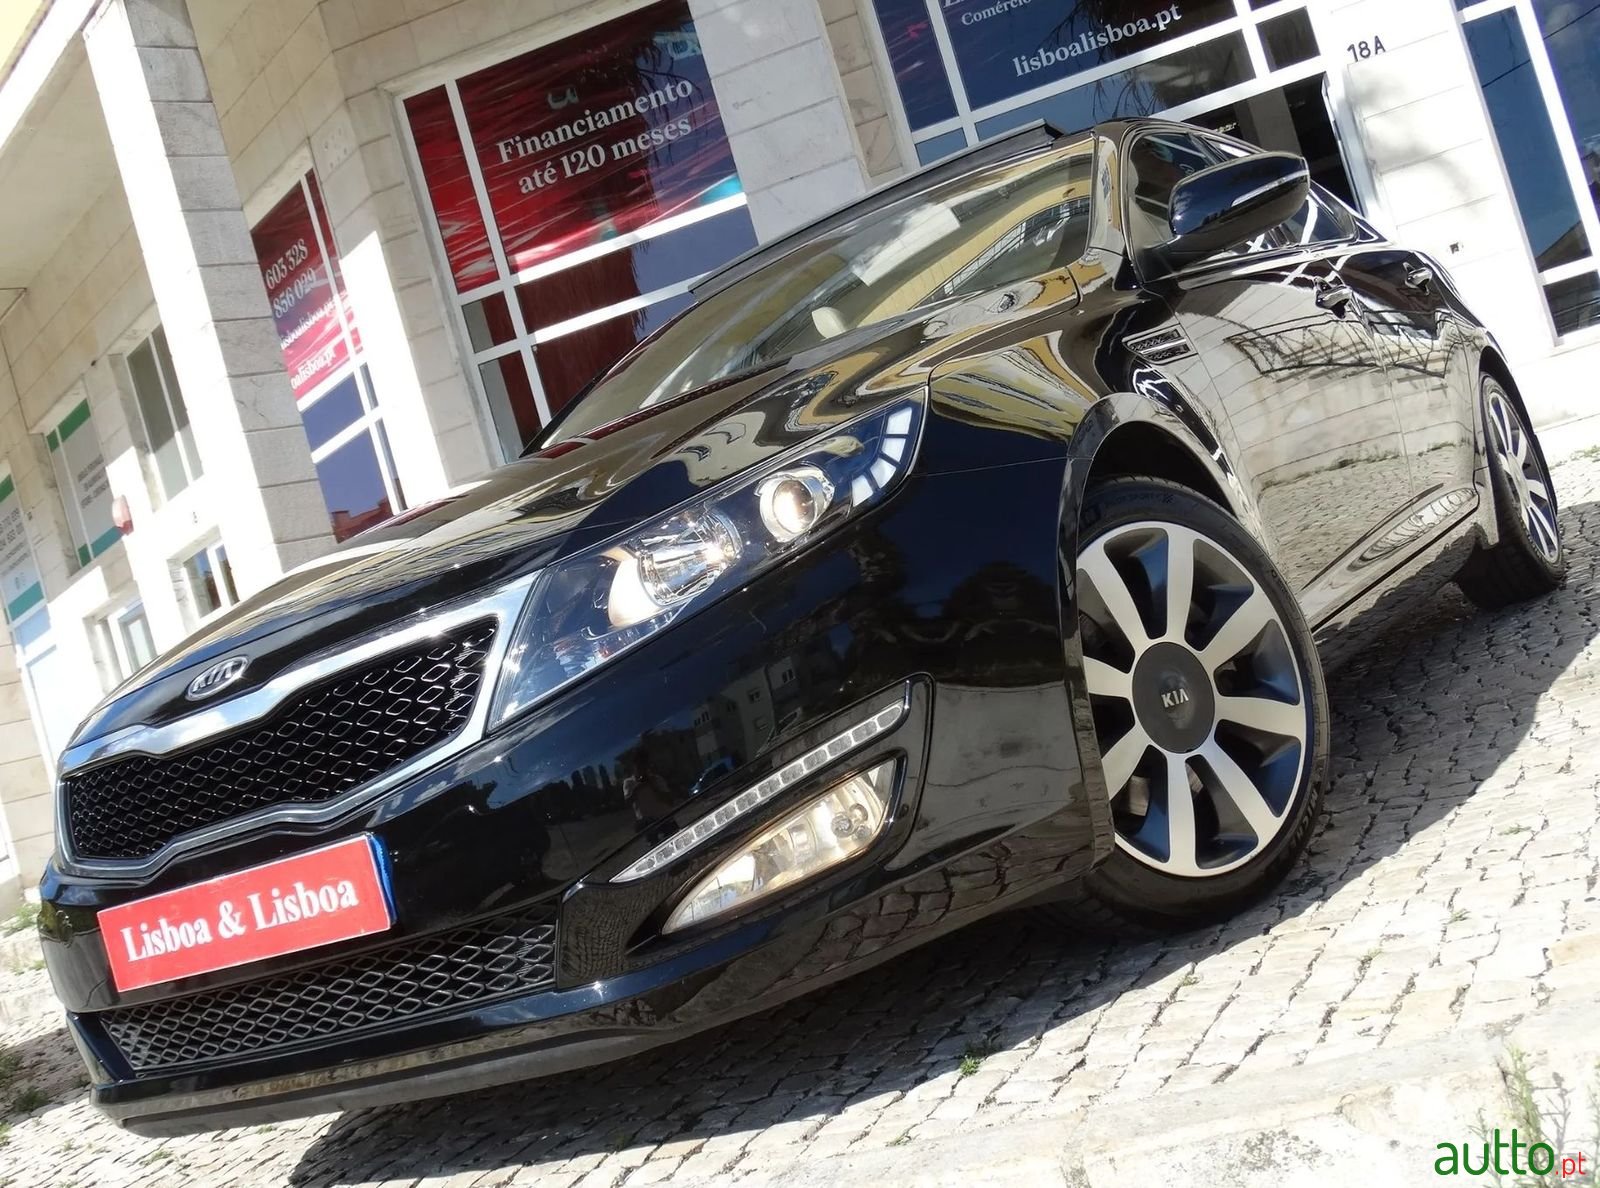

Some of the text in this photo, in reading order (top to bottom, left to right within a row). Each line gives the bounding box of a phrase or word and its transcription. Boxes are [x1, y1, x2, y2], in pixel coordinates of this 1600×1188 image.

[1012, 3, 1183, 77] lisboalisboa.pt
[496, 79, 694, 164] Financiamento
[518, 117, 693, 195] até 120 meses
[265, 237, 309, 290] 603 328
[272, 285, 296, 319] 856
[1160, 687, 1190, 709] KIA
[120, 879, 360, 962] Lisboa & Lisboa
